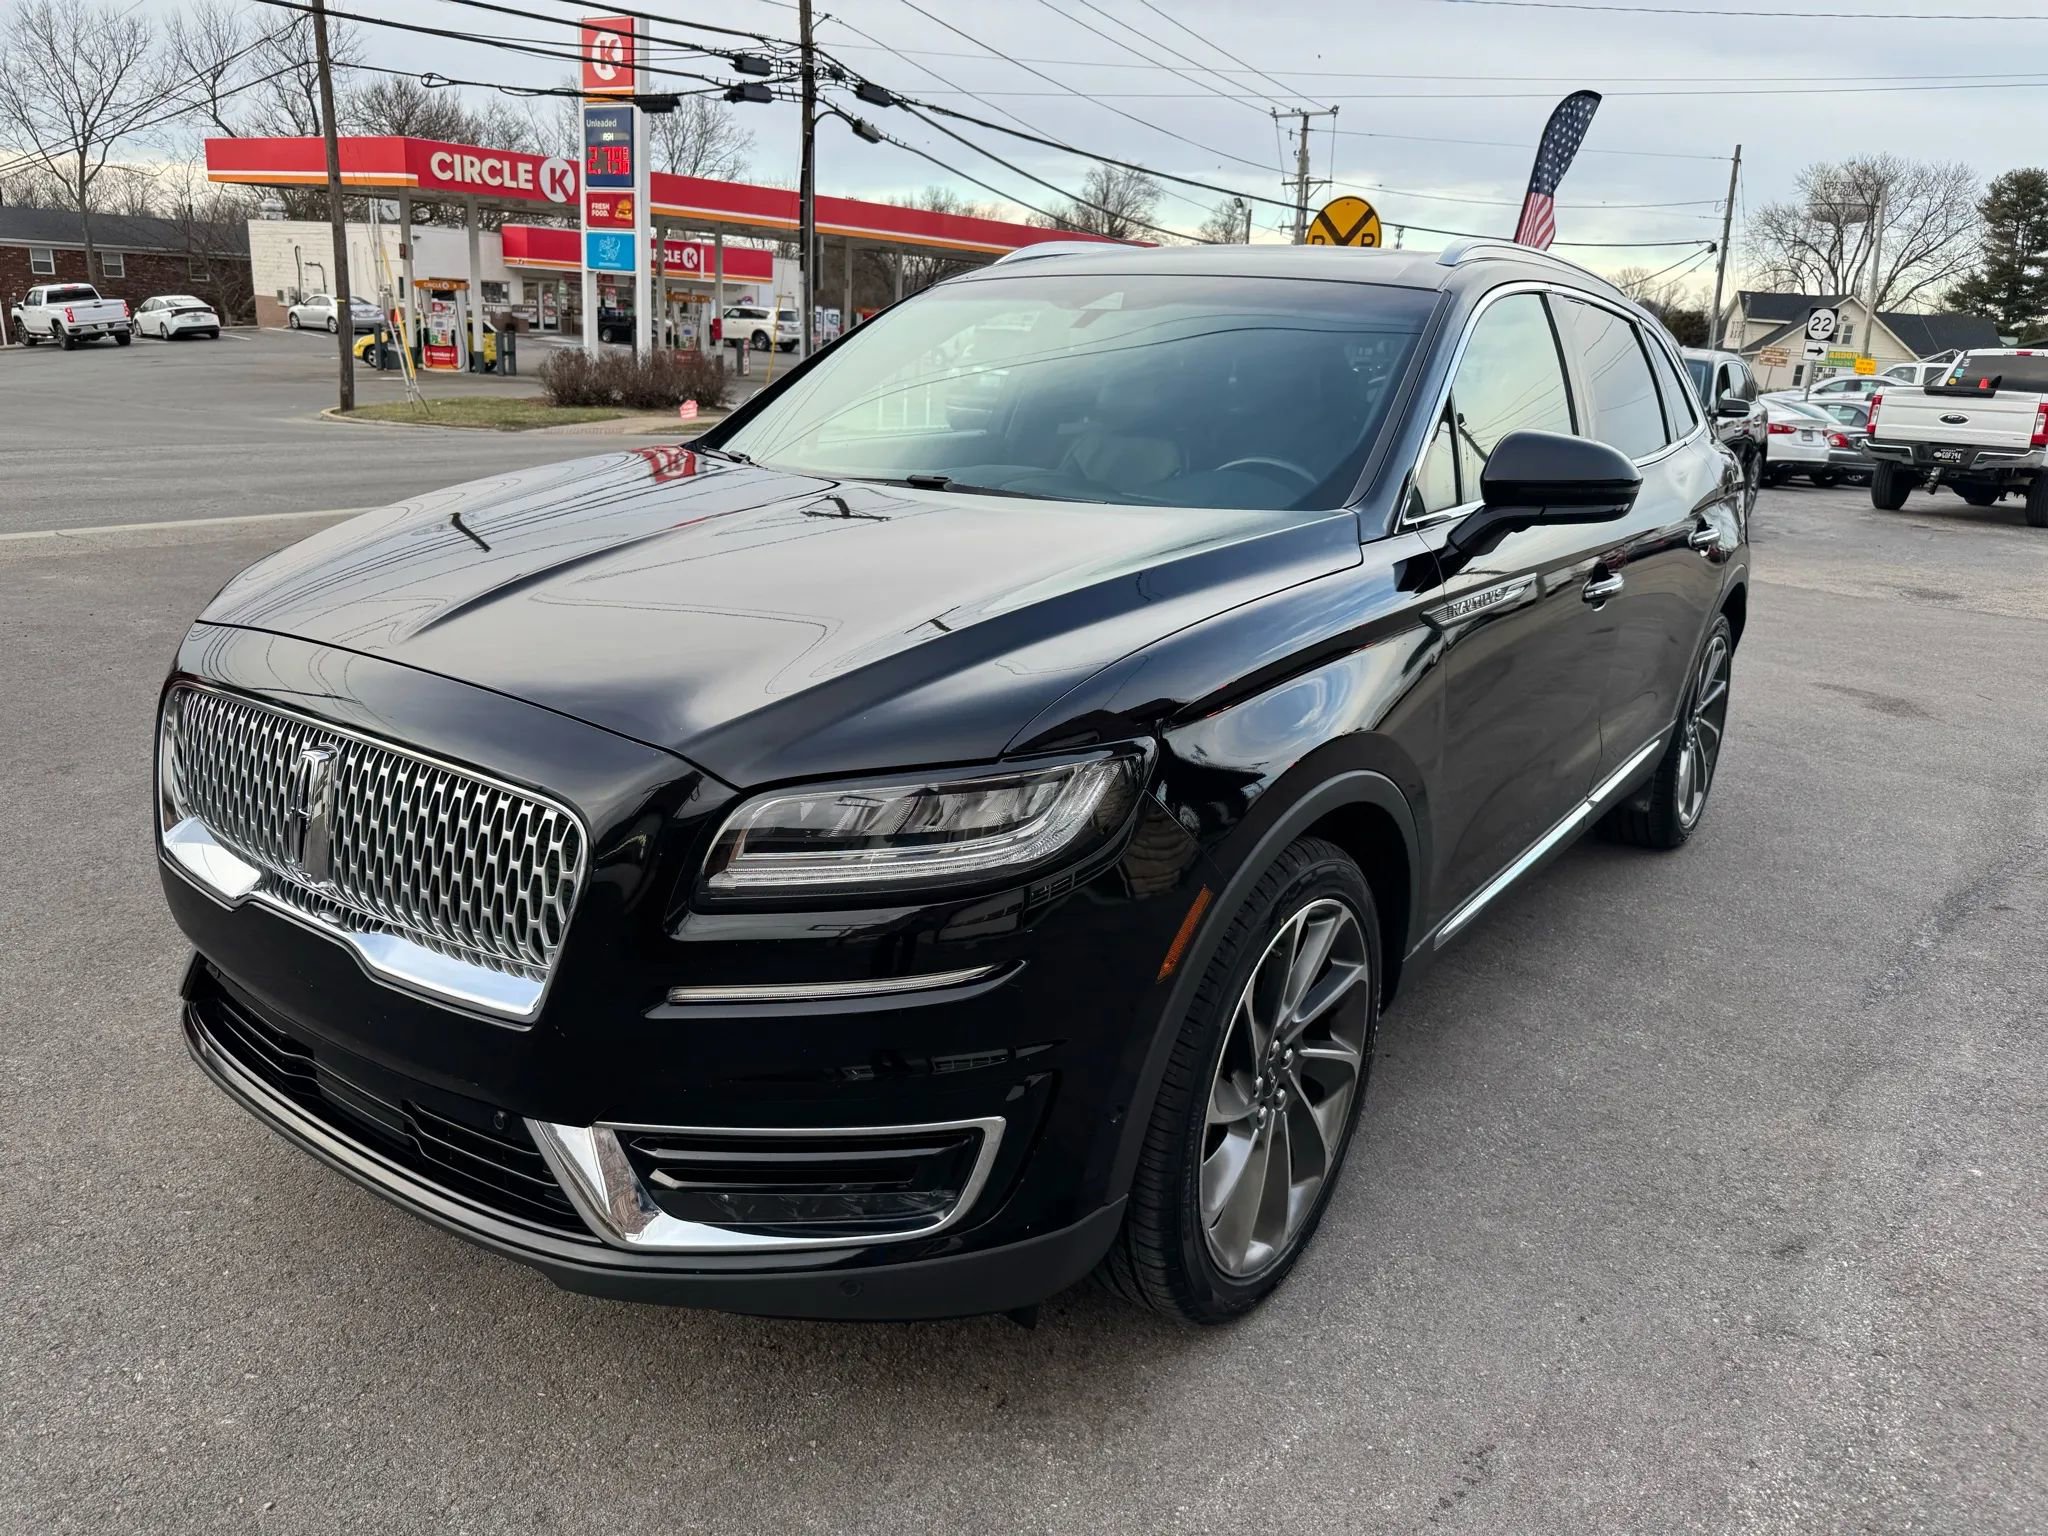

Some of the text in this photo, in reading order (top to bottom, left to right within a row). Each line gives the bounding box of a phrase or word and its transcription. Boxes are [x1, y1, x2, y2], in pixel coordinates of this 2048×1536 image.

[586, 119, 617, 128] Unleaded
[430, 151, 534, 190] CIRCLE
[591, 202, 610, 210] FRESH
[1810, 316, 1832, 332] 22
